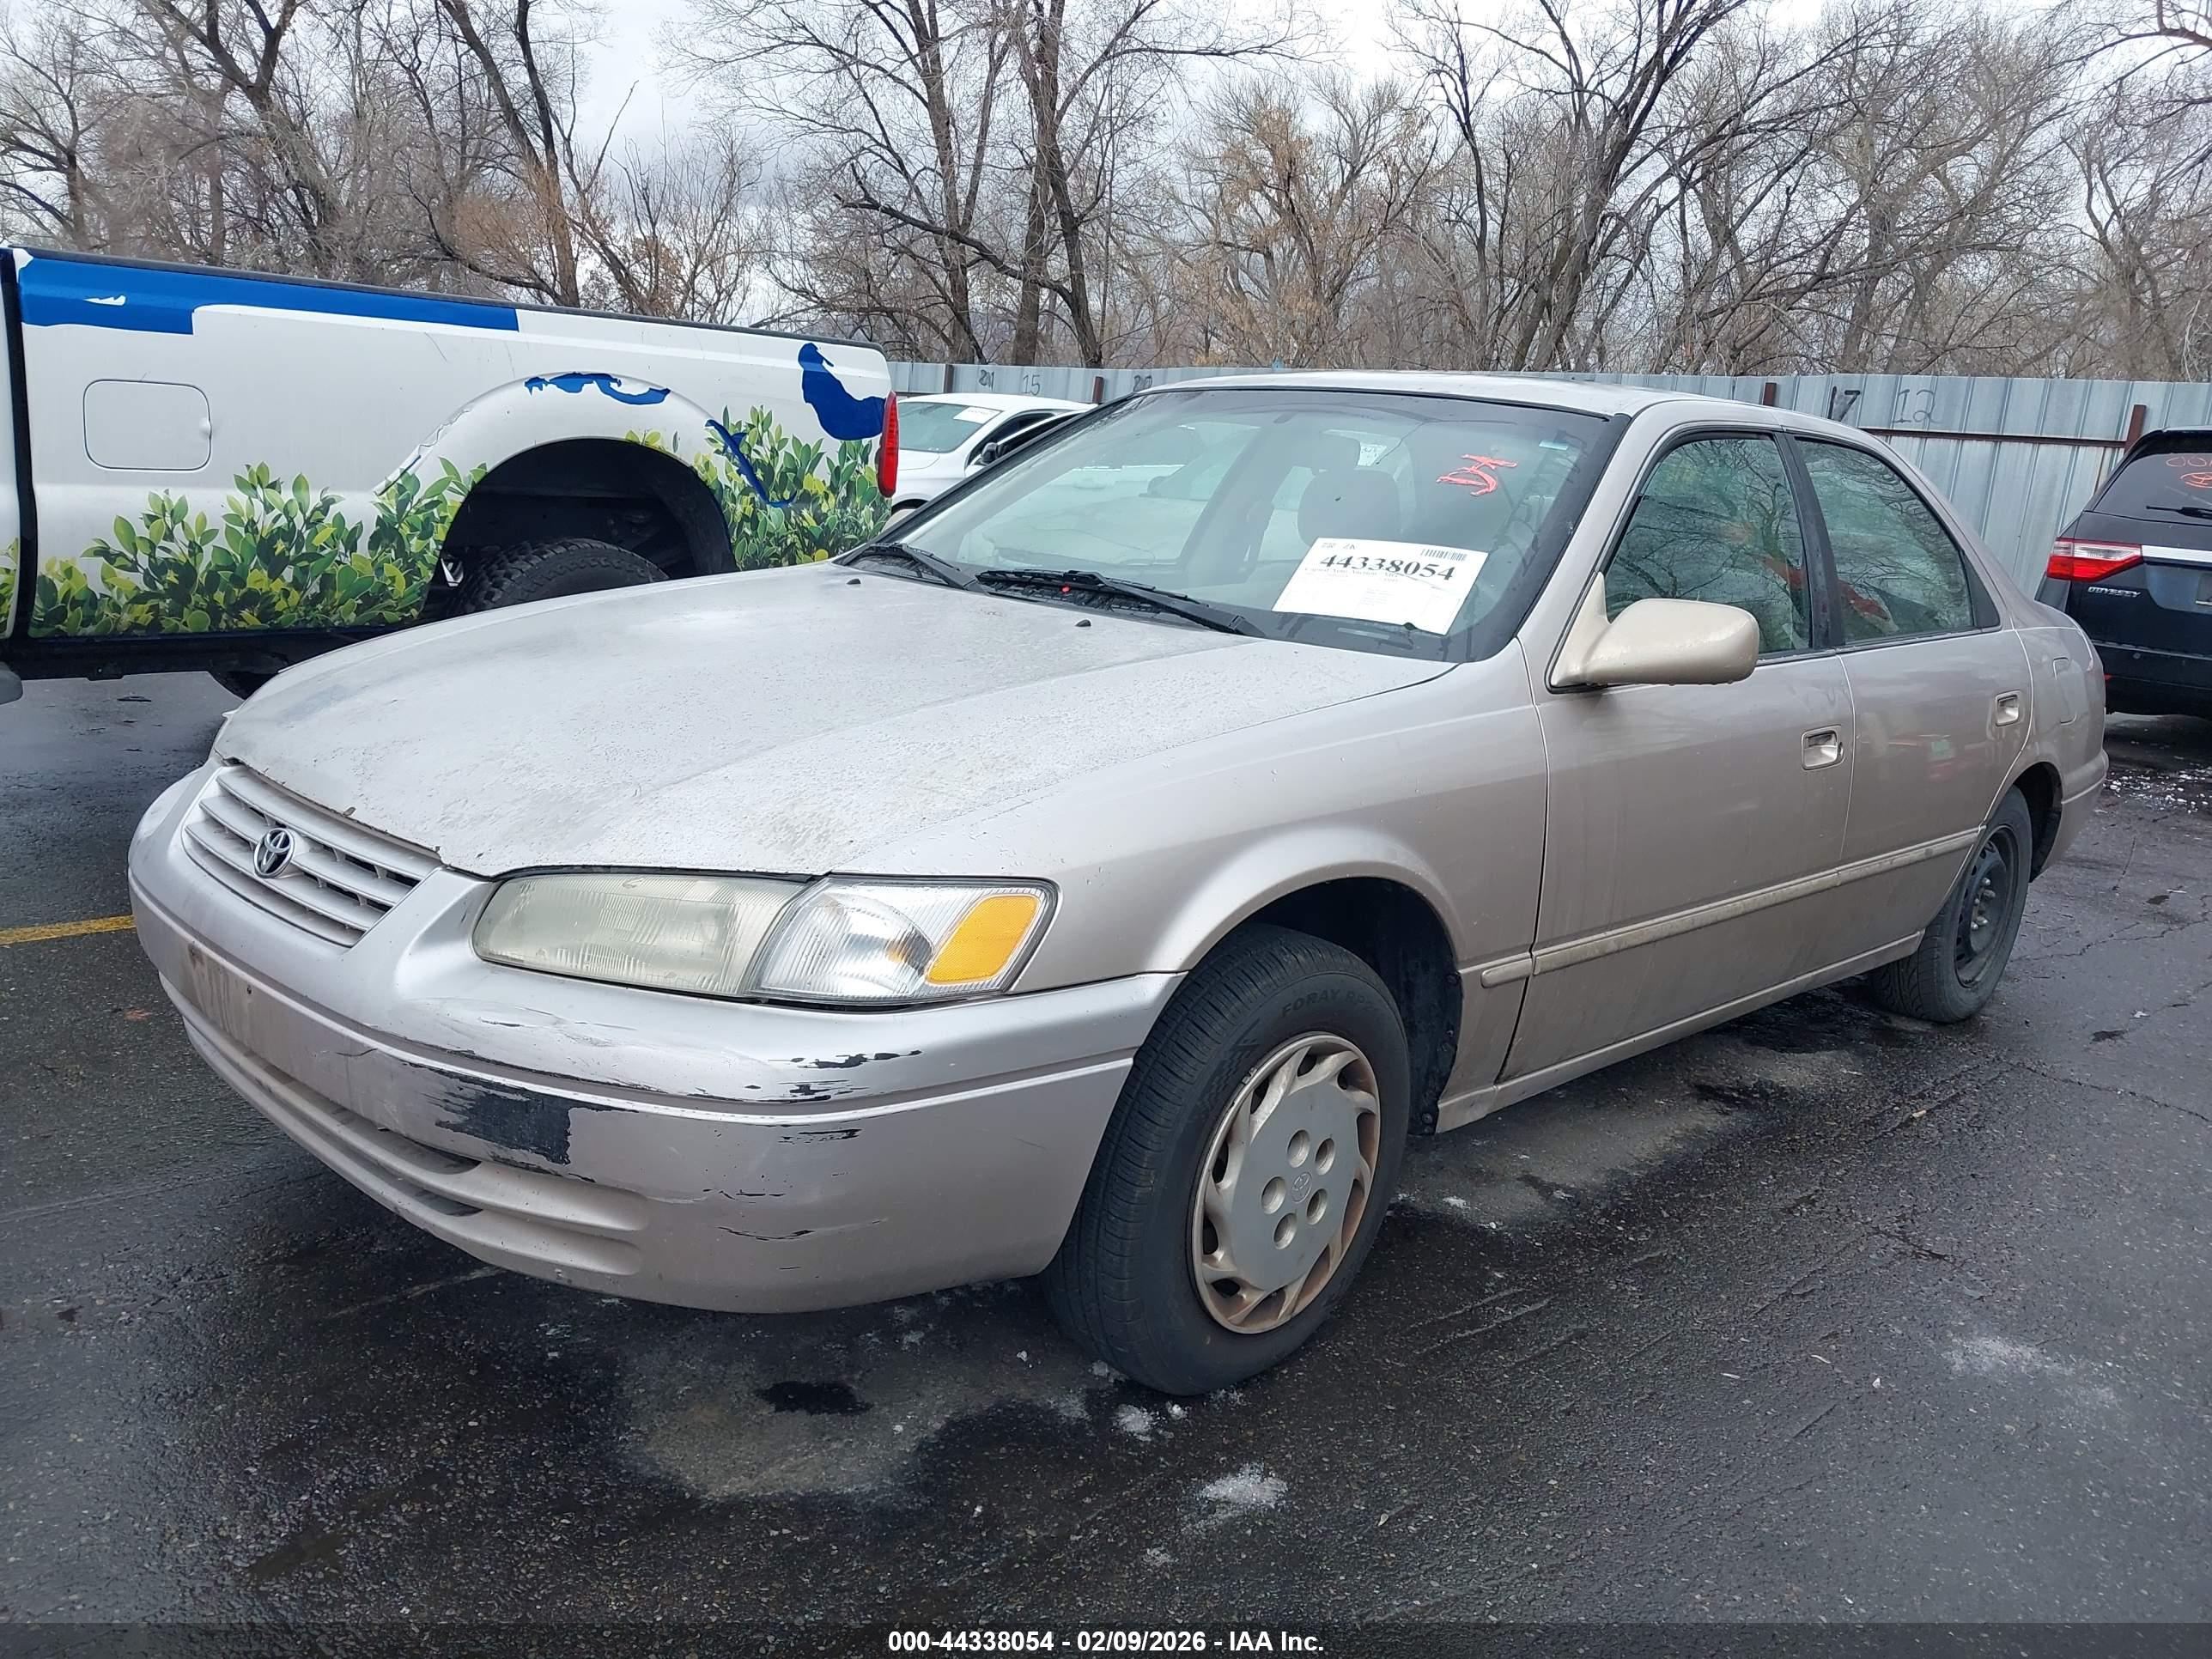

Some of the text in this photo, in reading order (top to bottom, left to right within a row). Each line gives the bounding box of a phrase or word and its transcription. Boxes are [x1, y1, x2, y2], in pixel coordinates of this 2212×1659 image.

[1023, 374, 1041, 396] 15
[1320, 555, 1455, 580] 44338054
[2087, 586, 2142, 599] ODYSSEY
